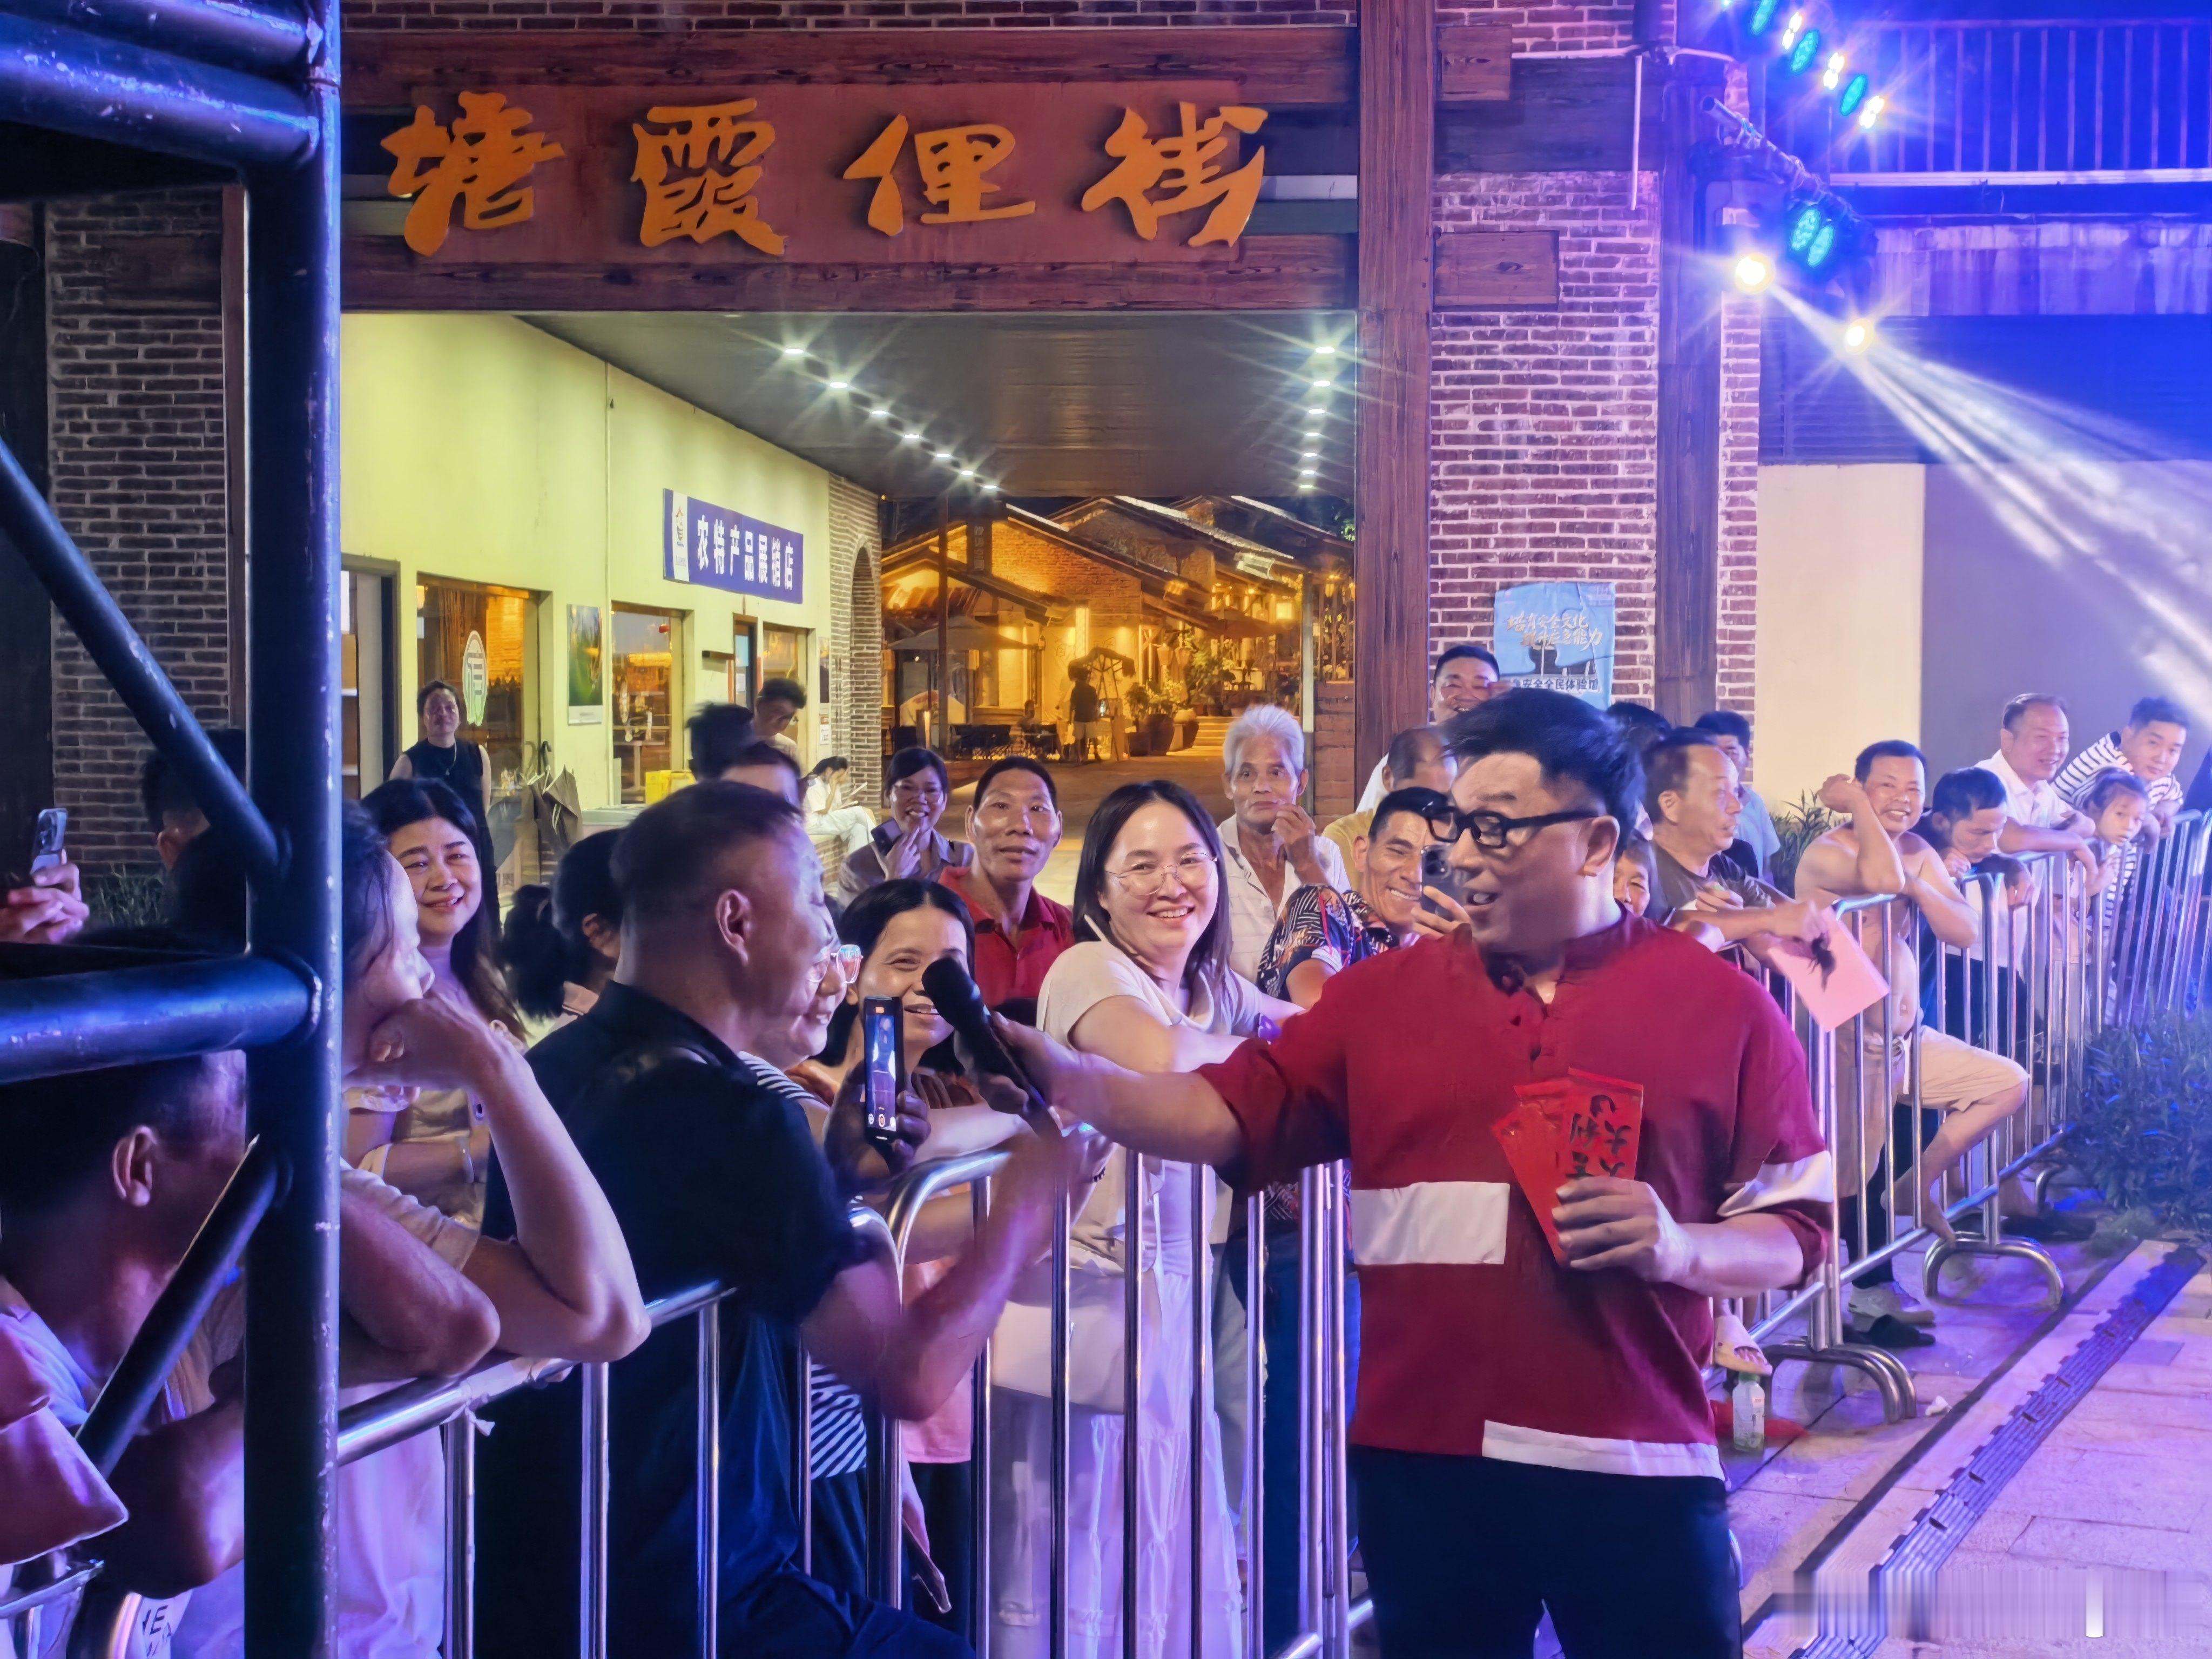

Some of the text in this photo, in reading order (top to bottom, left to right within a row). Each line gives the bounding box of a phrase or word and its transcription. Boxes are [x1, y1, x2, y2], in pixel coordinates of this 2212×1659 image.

[697, 514, 793, 590] 农特产品展销店
